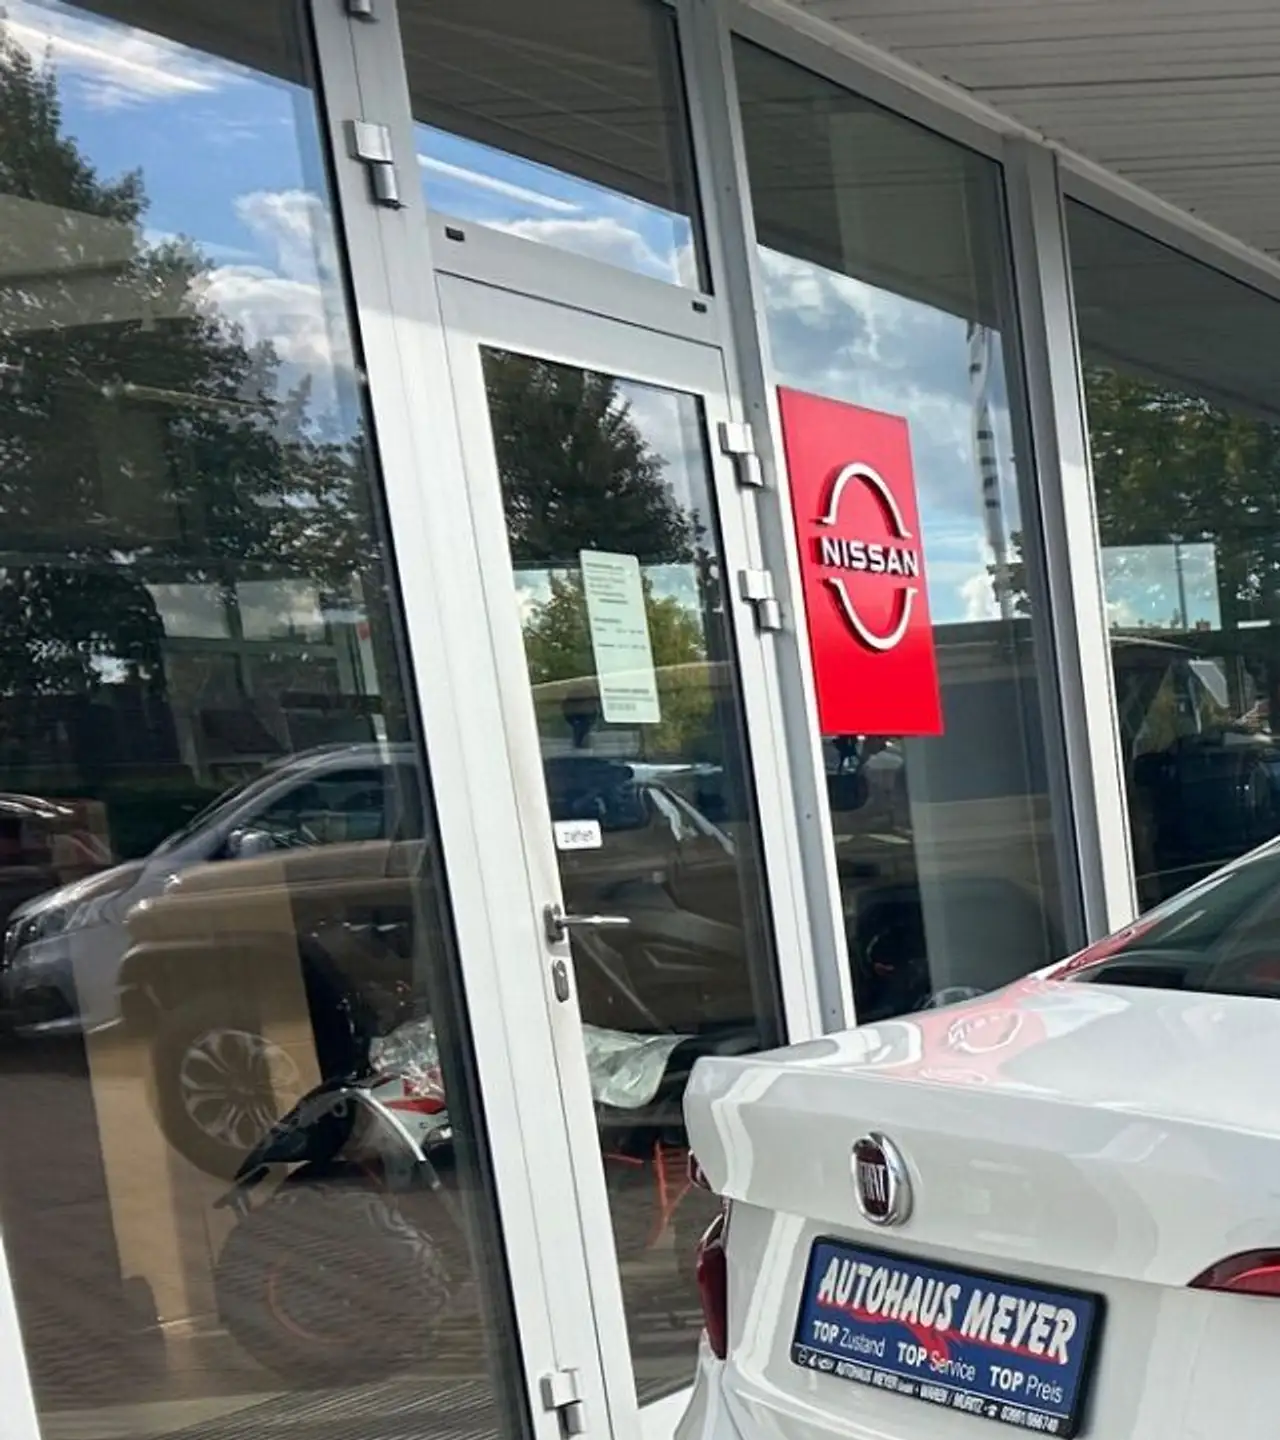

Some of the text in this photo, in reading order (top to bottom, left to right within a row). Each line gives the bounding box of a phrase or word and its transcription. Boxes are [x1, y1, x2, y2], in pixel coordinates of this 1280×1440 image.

[820, 536, 919, 577] NISSAN
[817, 1257, 1077, 1365] AUTOHAUS MEYER
[813, 1320, 1063, 1403] TOP Zustand TOP Service TOP Preis
